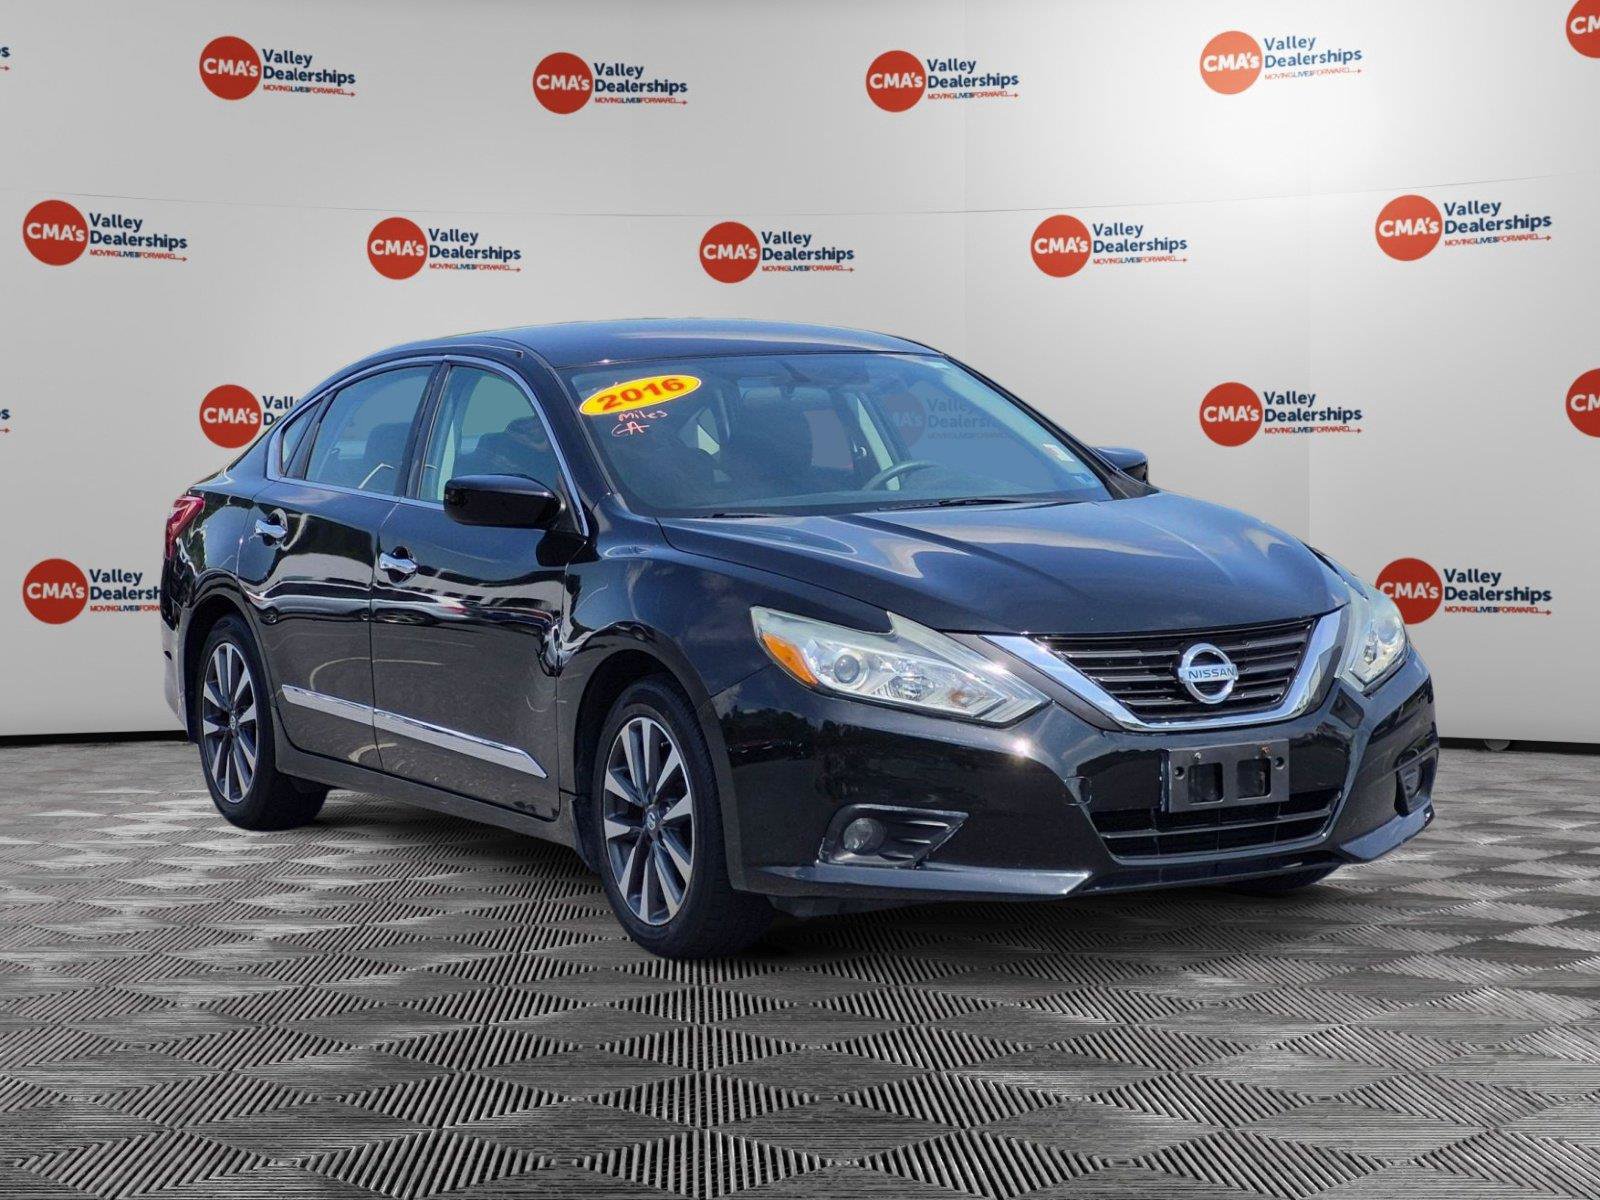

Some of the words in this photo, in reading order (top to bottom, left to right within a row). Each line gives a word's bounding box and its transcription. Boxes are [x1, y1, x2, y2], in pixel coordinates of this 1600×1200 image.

[1264, 36, 1316, 51] Valley
[262, 49, 313, 68] Valley
[927, 58, 977, 74] Valley
[1203, 52, 1261, 72] CMA's
[1265, 49, 1362, 68] Dealerships
[203, 58, 259, 77] CMA's
[263, 65, 356, 87] Dealerships
[594, 62, 644, 80] Valley
[536, 74, 590, 91] CMA's
[594, 79, 688, 95] Dealerships
[869, 72, 923, 89] CMA's
[927, 73, 1019, 89] Dealerships
[1443, 201, 1502, 217] Valley
[89, 212, 143, 233] Valley
[1092, 223, 1143, 238] Valley
[1379, 216, 1439, 237] CMA's
[1444, 214, 1552, 234] Dealerships
[26, 222, 85, 242] CMA's
[90, 230, 187, 251] Dealerships
[428, 228, 479, 246] Valley
[761, 231, 811, 247] Valley
[370, 239, 425, 257] CMA's
[429, 245, 522, 262] Dealerships
[703, 243, 757, 260] CMA's
[1034, 236, 1088, 254] CMA's
[1093, 237, 1188, 253] Dealerships
[761, 247, 854, 263] Dealerships
[262, 395, 300, 410] Vall
[597, 378, 686, 411] 2016
[1264, 391, 1316, 407] Valley
[203, 407, 258, 424] CMA's
[1203, 405, 1259, 422] CMA's
[1264, 407, 1362, 423] Dealerships
[89, 569, 143, 586] Valley
[1443, 568, 1502, 586] Valley
[27, 582, 85, 599] CMA's
[90, 586, 161, 600] Dealersh
[1379, 581, 1439, 600] CMA's
[1444, 586, 1552, 605] Dealerships
[1188, 667, 1235, 679] NISSAN
